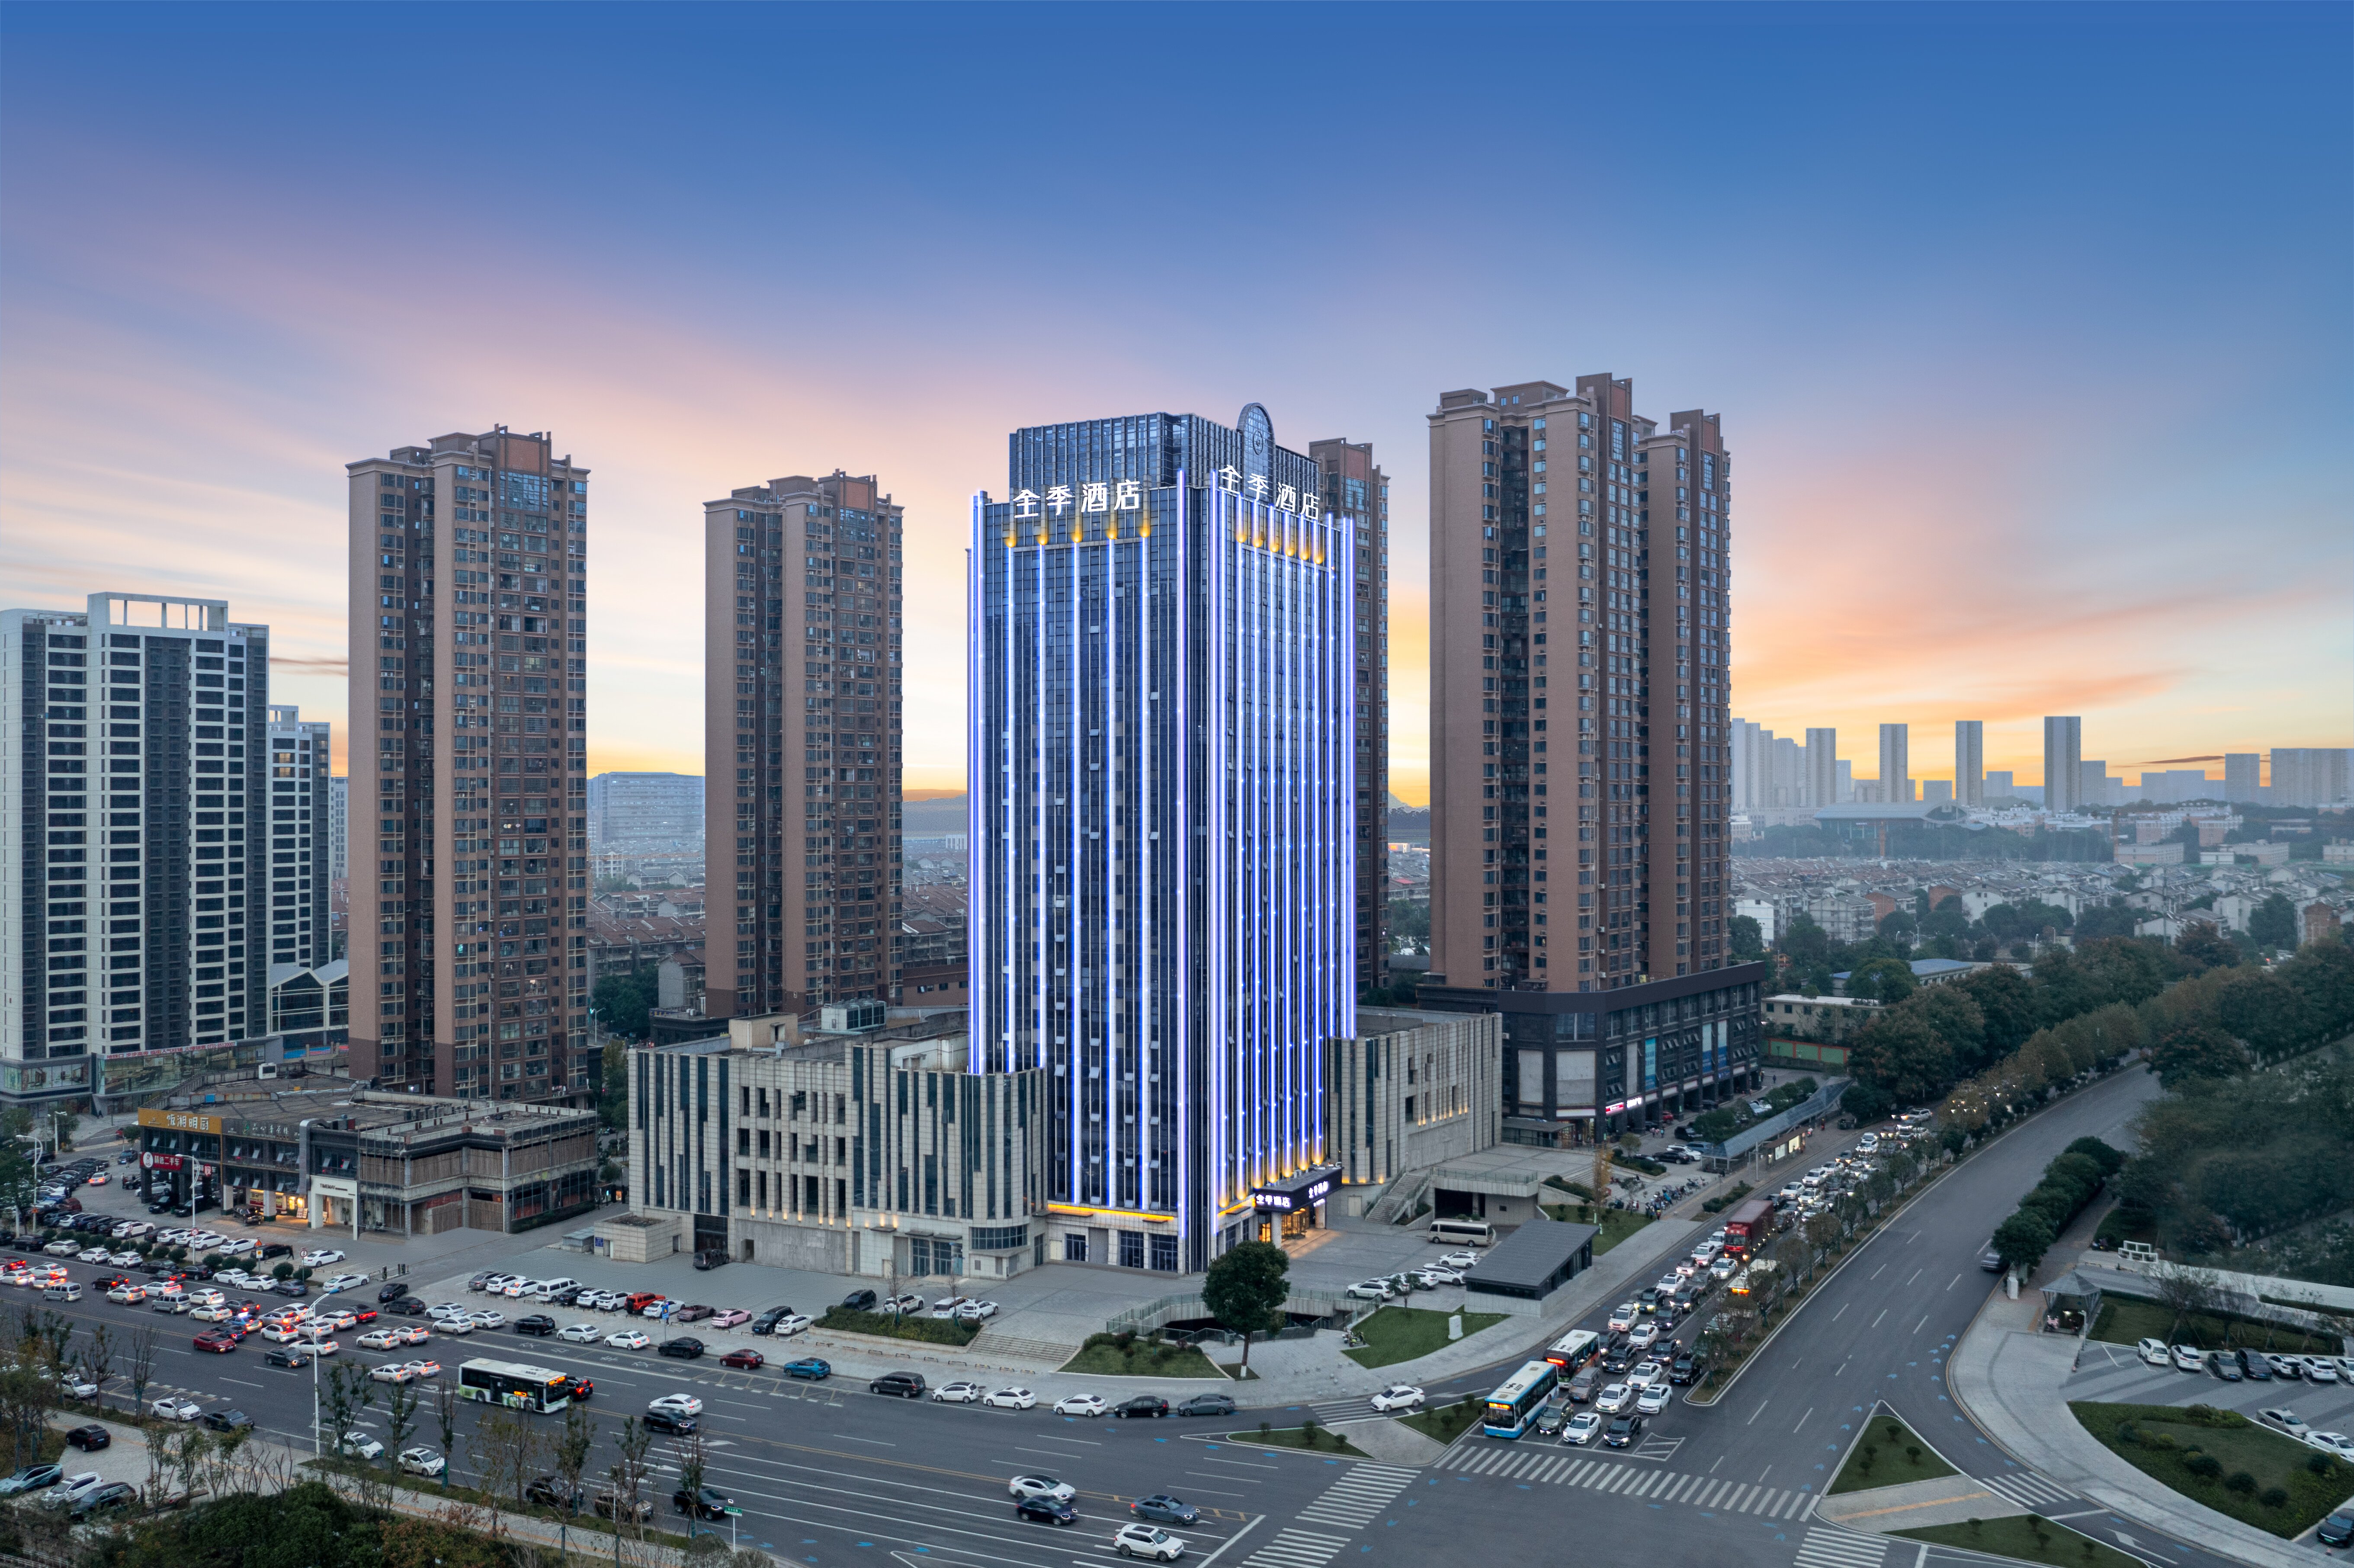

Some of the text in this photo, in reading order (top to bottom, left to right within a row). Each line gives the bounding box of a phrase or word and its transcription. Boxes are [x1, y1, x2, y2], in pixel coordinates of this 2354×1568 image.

[1013, 479, 1140, 519] 全季酒店
[1218, 464, 1320, 520] 全季酒店
